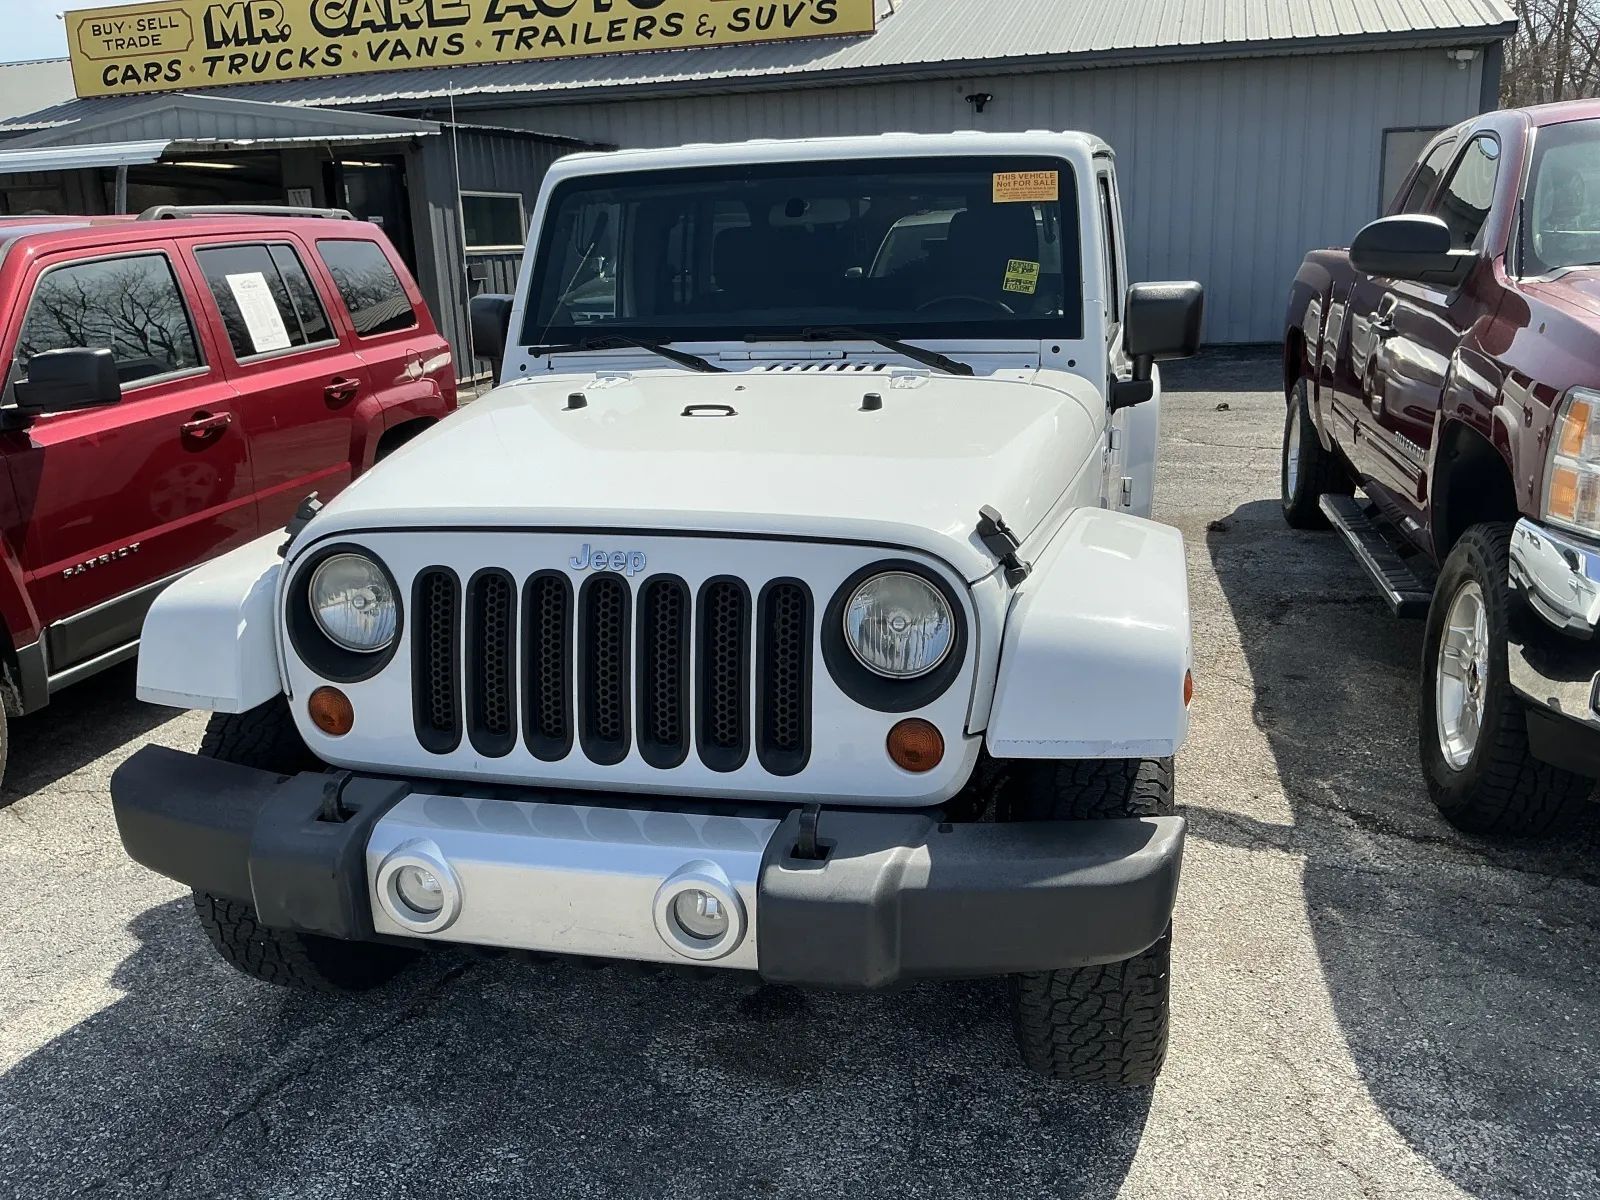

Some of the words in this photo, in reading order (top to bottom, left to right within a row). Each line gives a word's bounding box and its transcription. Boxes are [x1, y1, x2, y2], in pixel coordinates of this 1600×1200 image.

[92, 22, 123, 37] BUY
[137, 15, 179, 31] SELL
[203, 0, 292, 49] MR.
[310, 0, 471, 38] CARE
[103, 34, 162, 52] TRADE
[103, 59, 181, 87] CARS
[202, 43, 343, 77] TRUCKS
[367, 32, 465, 62] VANS
[491, 12, 685, 52] TRAILERS
[695, 13, 717, 37] &
[727, 0, 838, 32] SUV'S
[996, 180, 1011, 188] Not
[997, 173, 1016, 181] THIS
[1018, 172, 1056, 180] VEHICLE
[62, 542, 140, 578] PATRIOT
[569, 543, 647, 577] Jeep
